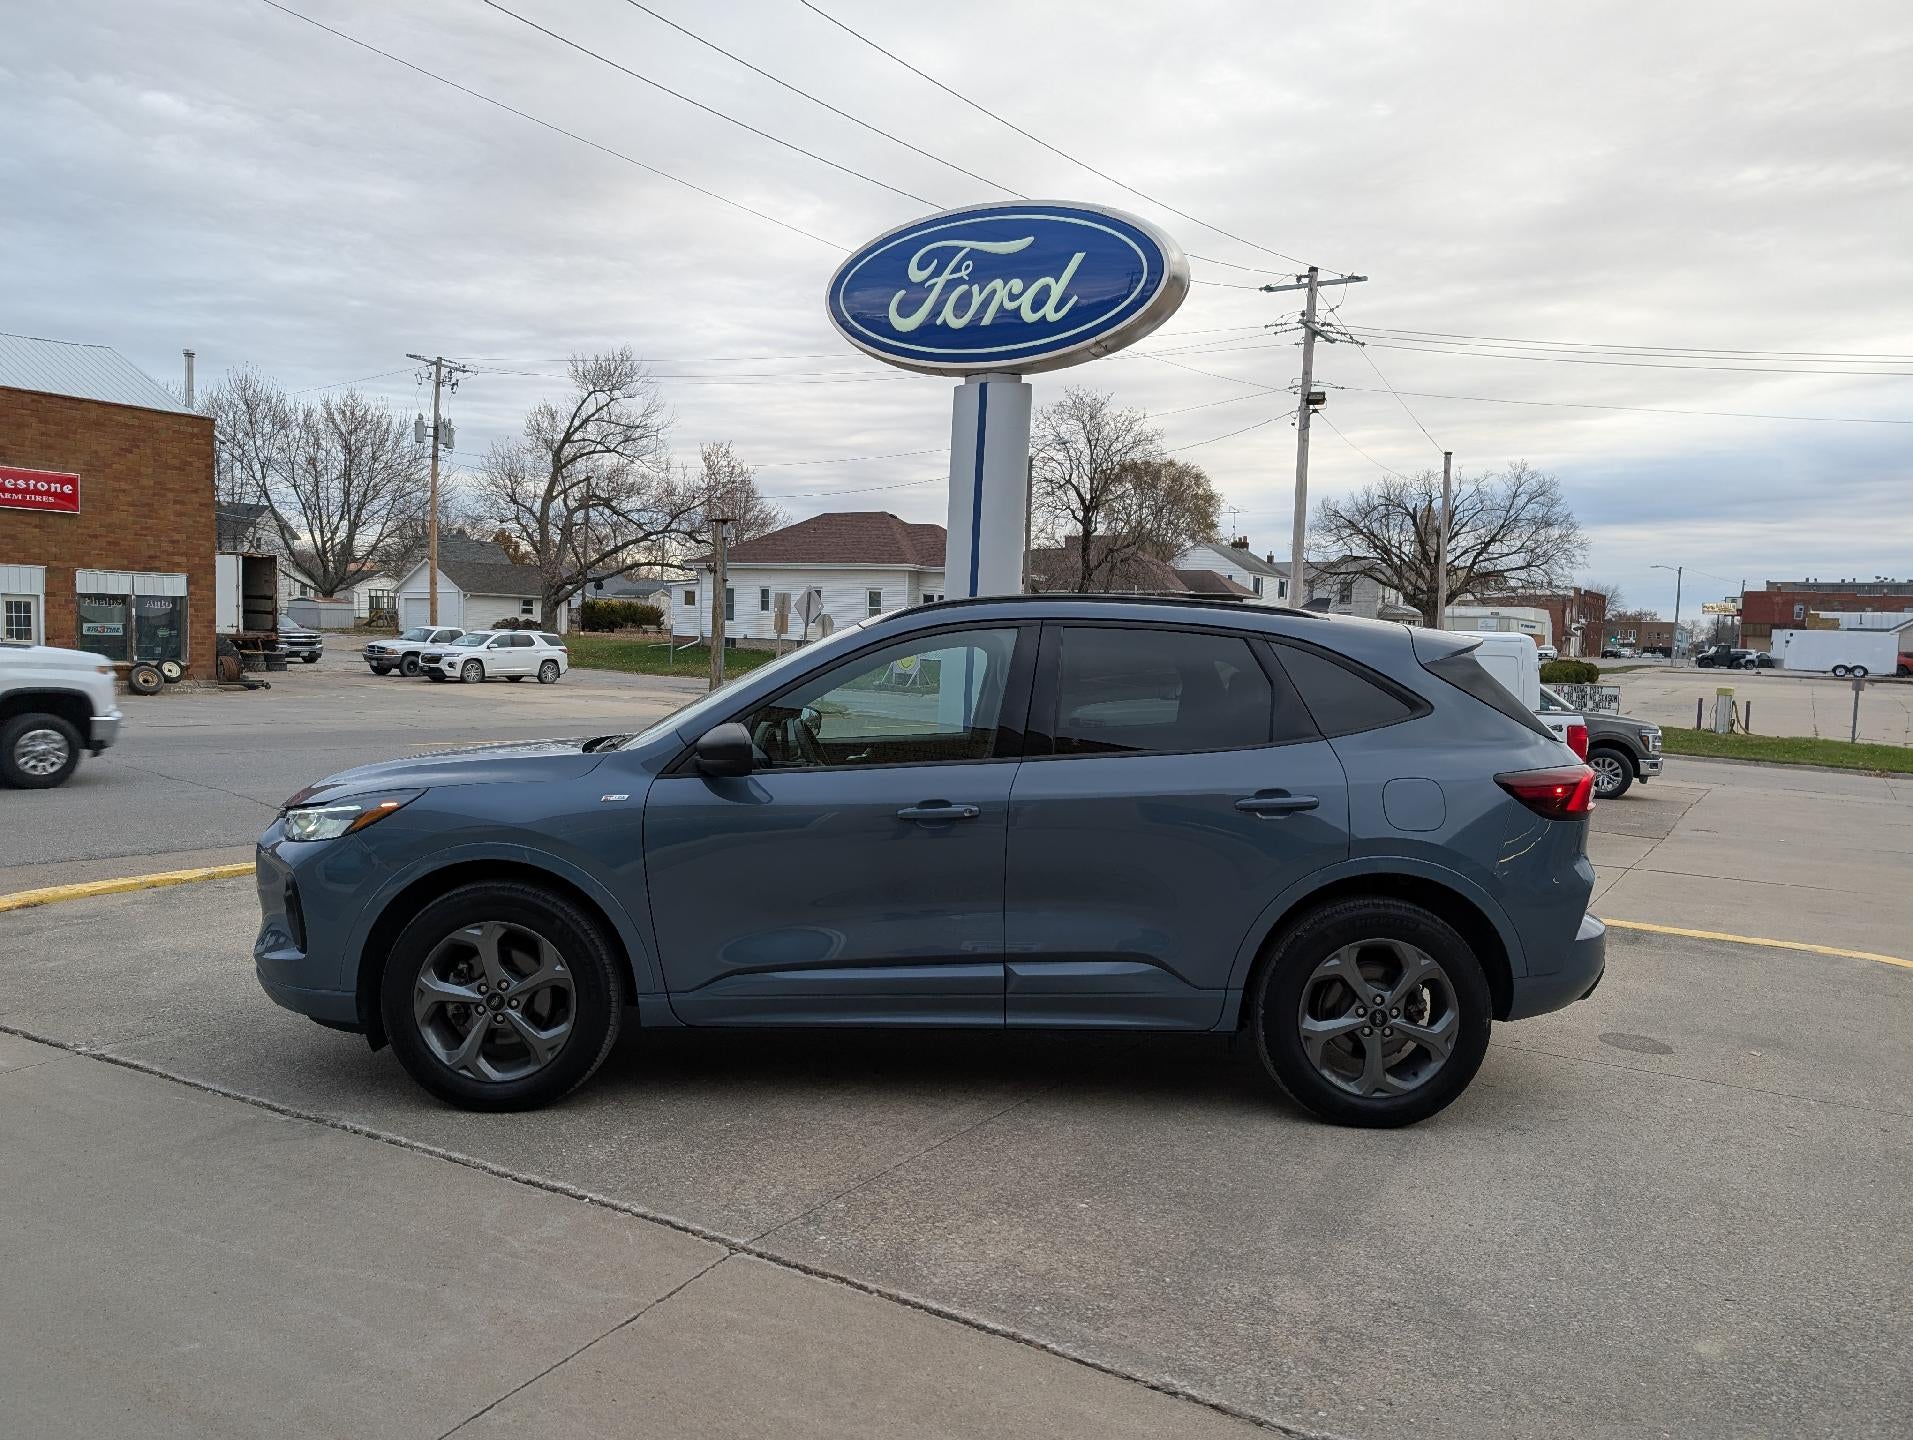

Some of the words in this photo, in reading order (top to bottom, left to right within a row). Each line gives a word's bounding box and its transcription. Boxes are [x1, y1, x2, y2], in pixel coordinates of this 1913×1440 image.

[888, 236, 1086, 332] Ford
[25, 494, 55, 503] TIRES
[83, 597, 123, 609] Phelps
[144, 599, 173, 609] Auto
[1589, 686, 1604, 695] POST
[1598, 694, 1618, 703] SEASON
